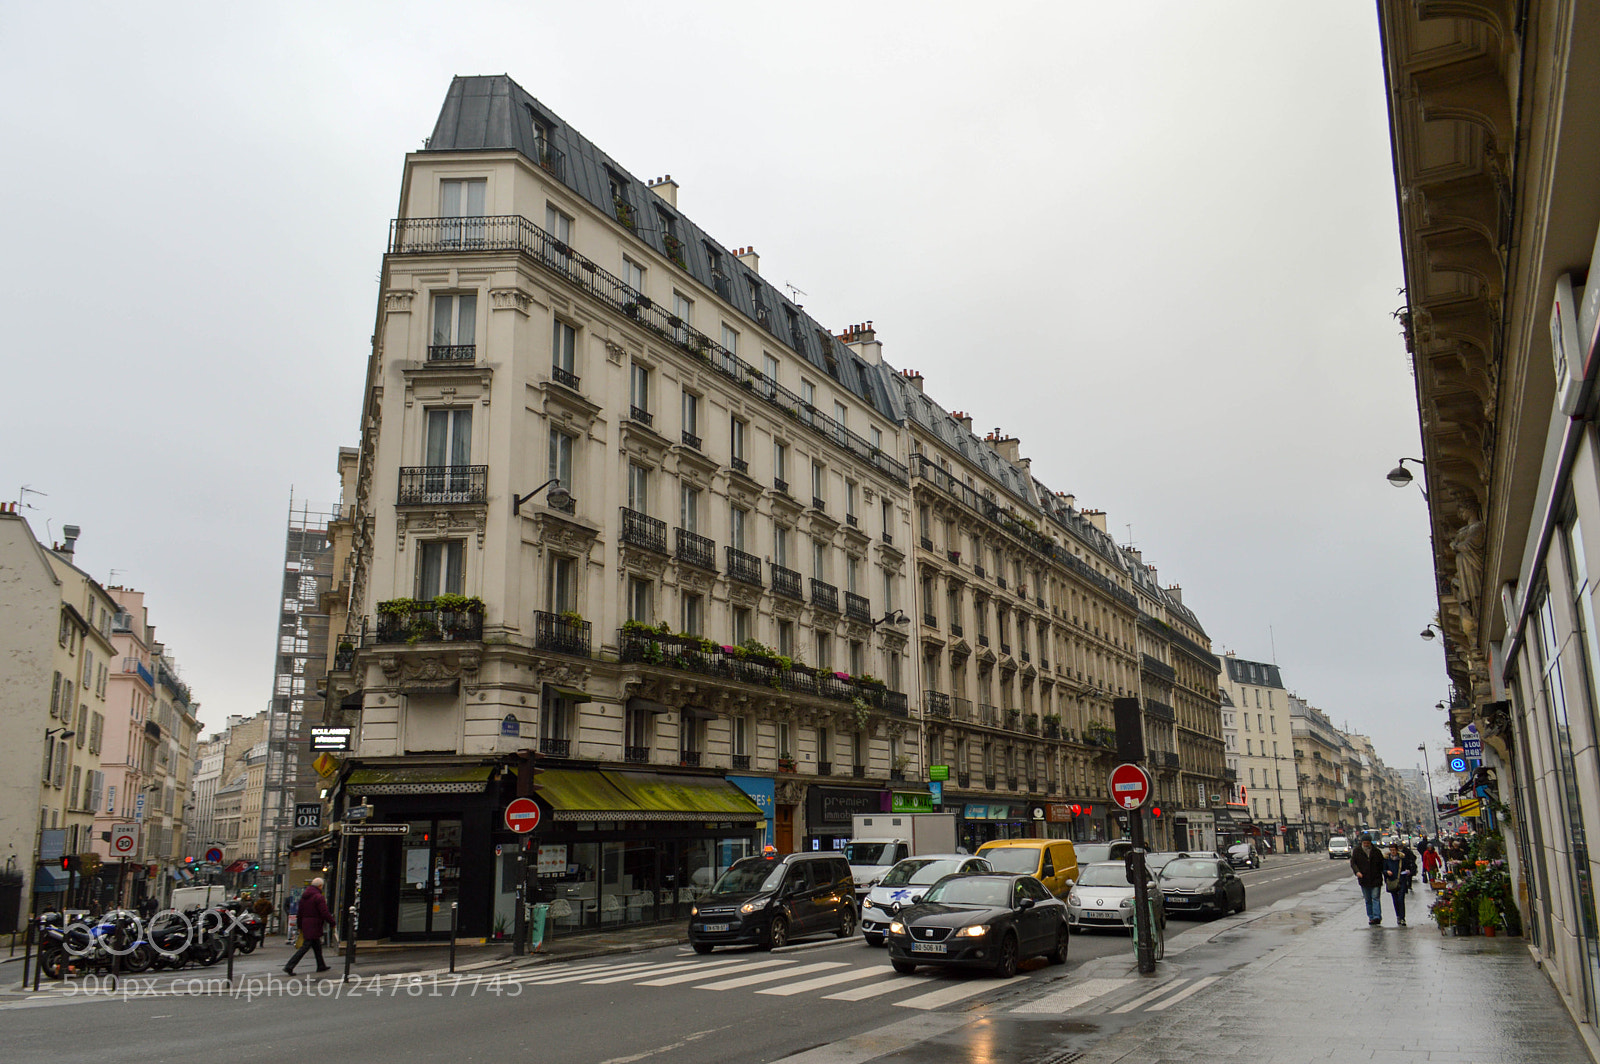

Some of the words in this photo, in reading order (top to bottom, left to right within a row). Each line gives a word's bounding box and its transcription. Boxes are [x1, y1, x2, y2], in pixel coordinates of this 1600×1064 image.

[824, 794, 869, 809] premier
[298, 807, 320, 815] ACHAT
[297, 815, 318, 826] OR
[118, 840, 131, 848] 30
